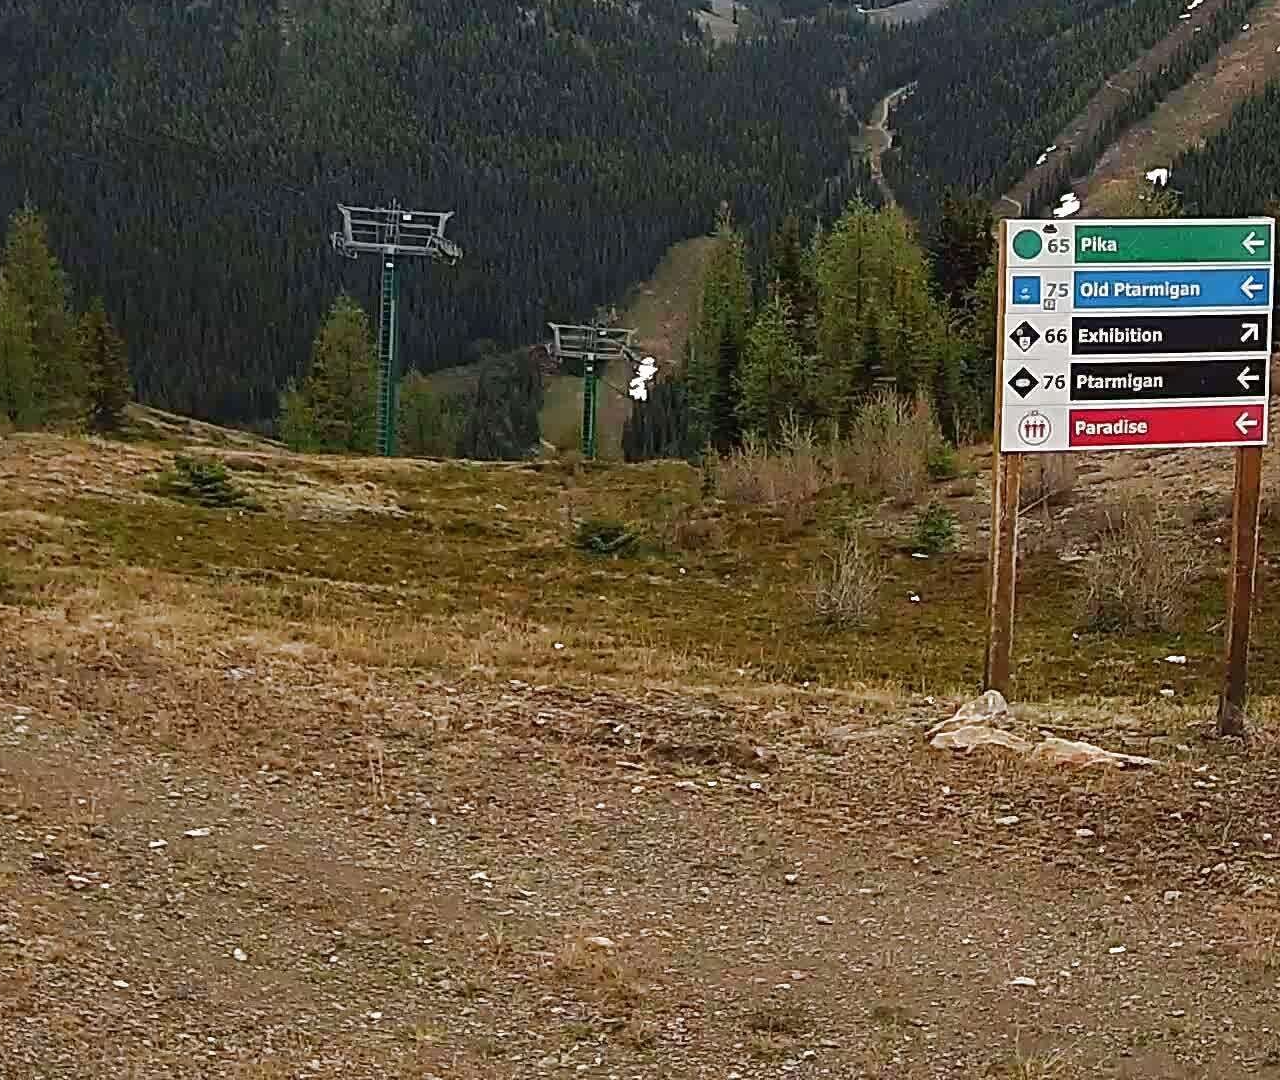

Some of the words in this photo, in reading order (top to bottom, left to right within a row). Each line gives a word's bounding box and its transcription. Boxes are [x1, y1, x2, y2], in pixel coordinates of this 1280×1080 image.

[1047, 238, 1070, 253] 65
[1081, 237, 1117, 253] Pika
[1046, 283, 1069, 298] 75
[1080, 282, 1109, 298] Old
[1114, 282, 1200, 299] Ptarmigan
[1044, 328, 1068, 343] 66
[1078, 327, 1163, 343] Exhibition
[1043, 375, 1066, 389] 76
[1076, 374, 1163, 392] Ptarmigan
[1075, 420, 1148, 435] Paradise
